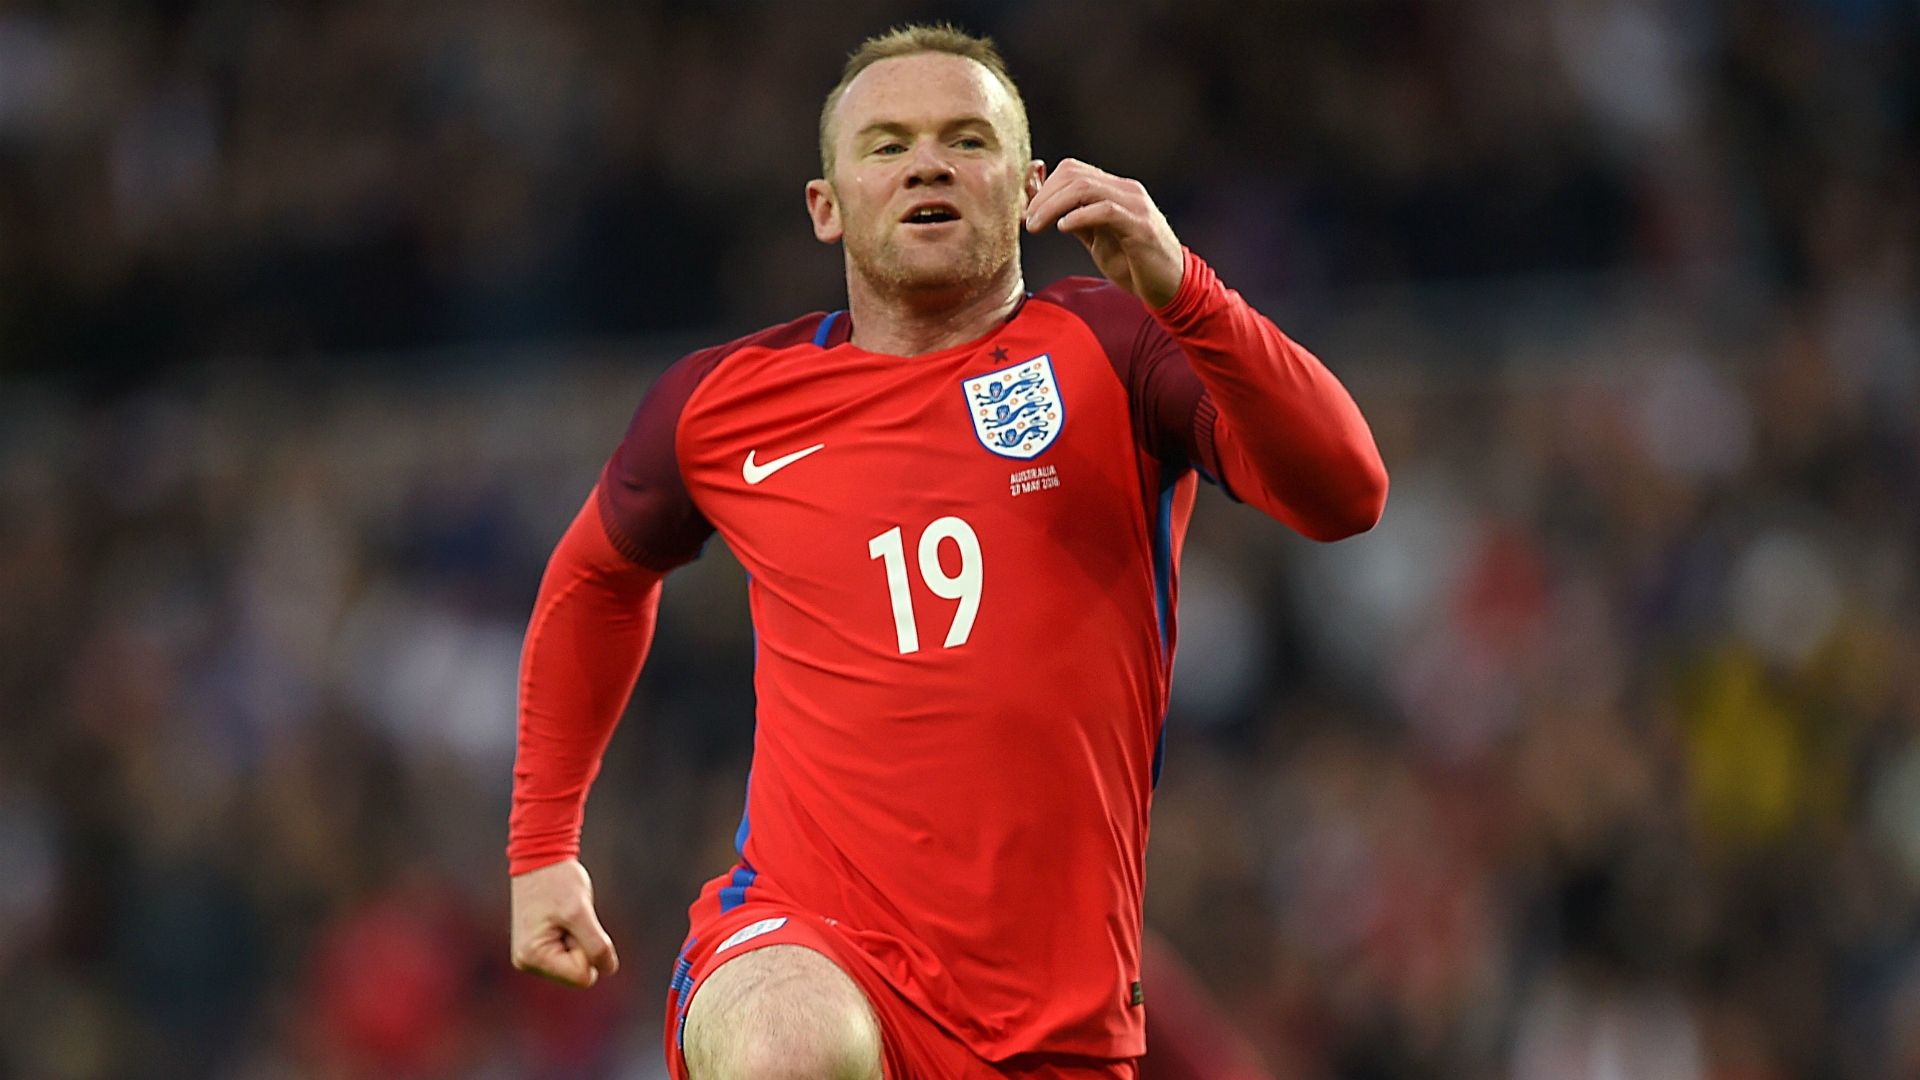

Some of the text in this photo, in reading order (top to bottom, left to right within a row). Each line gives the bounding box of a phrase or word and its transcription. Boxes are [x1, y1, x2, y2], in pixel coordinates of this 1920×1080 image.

[1010, 465, 1056, 484] AUSTRALIA
[1021, 480, 1041, 493] MAY
[868, 516, 983, 655] 19
